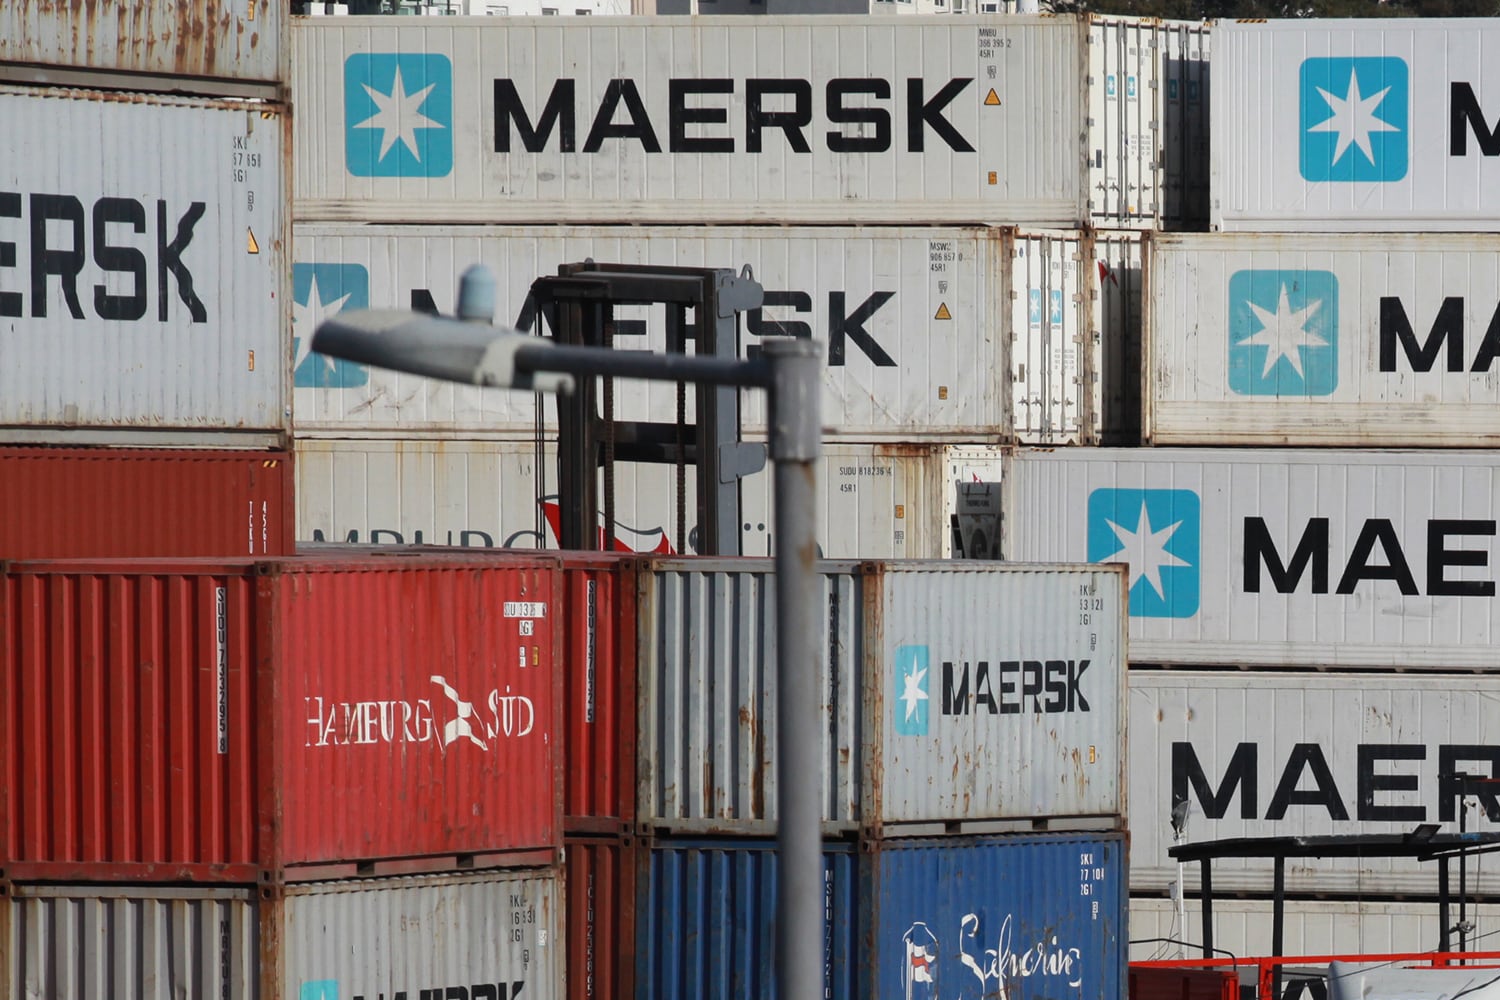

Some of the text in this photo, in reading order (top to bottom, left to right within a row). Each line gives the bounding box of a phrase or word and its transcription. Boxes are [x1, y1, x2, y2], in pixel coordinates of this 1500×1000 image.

[992, 39, 1005, 48] 395
[1006, 39, 1012, 48] 2
[494, 78, 975, 153] MAERSK
[930, 253, 963, 262] 906 857 0
[930, 264, 946, 272] 45R1
[839, 466, 857, 475] SUDU
[840, 484, 857, 493] 45R1
[218, 588, 227, 752] SUDU 733295 8
[942, 660, 1091, 715] MAERSK
[304, 696, 433, 747] HAMBURG
[824, 869, 834, 921] MSKU
[221, 920, 231, 979] MRKU
[824, 924, 832, 999] 777210
